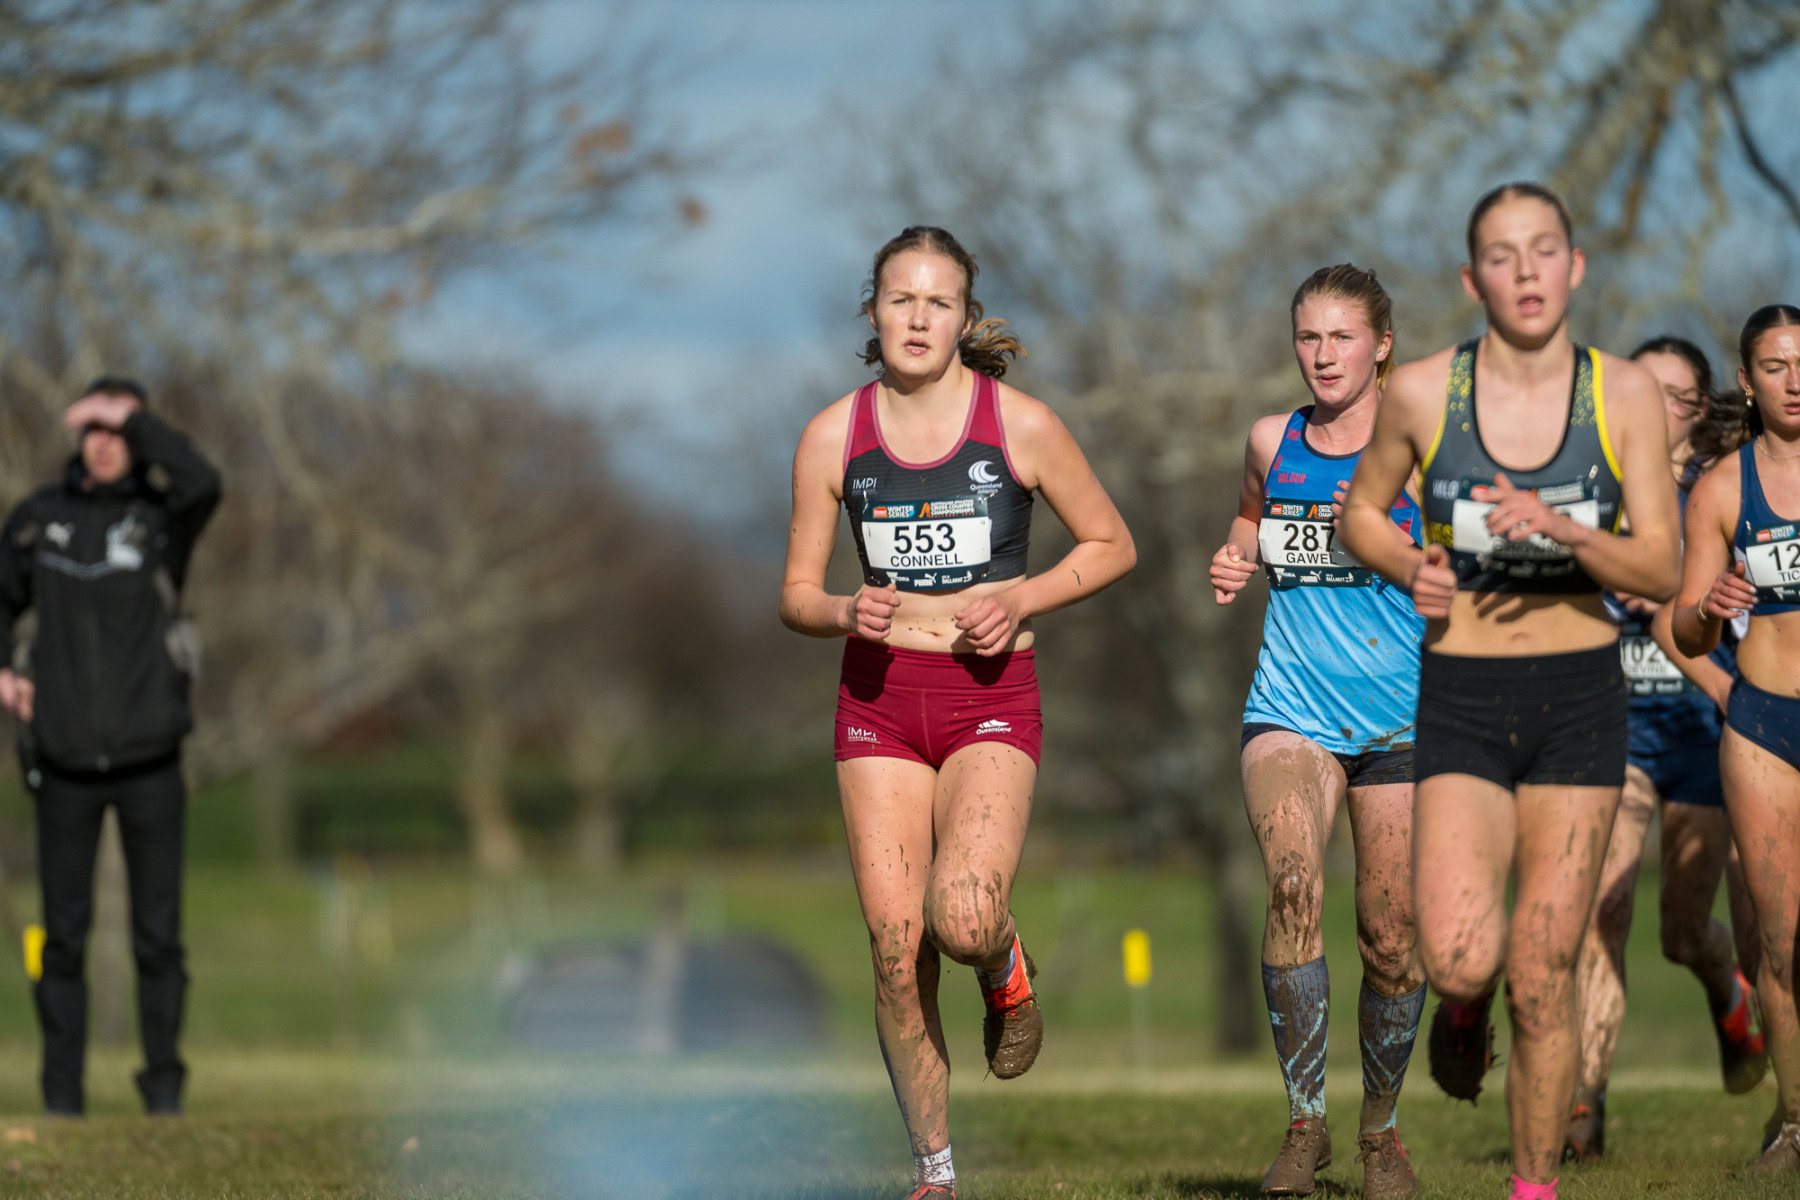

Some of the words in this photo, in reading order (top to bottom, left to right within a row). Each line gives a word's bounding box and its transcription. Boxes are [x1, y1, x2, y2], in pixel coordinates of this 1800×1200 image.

[852, 477, 877, 490] IMPI
[1278, 472, 1306, 484] VALOUR
[970, 481, 1003, 492] Queensland
[1769, 525, 1794, 534] WINTER
[1771, 531, 1790, 540] SERIES
[894, 523, 956, 554] 553
[1283, 523, 1336, 552] 287
[890, 553, 963, 567] CONNELL
[1286, 552, 1338, 565] GAWEL
[914, 579, 933, 587] PUMA
[976, 727, 1012, 735] Queensland
